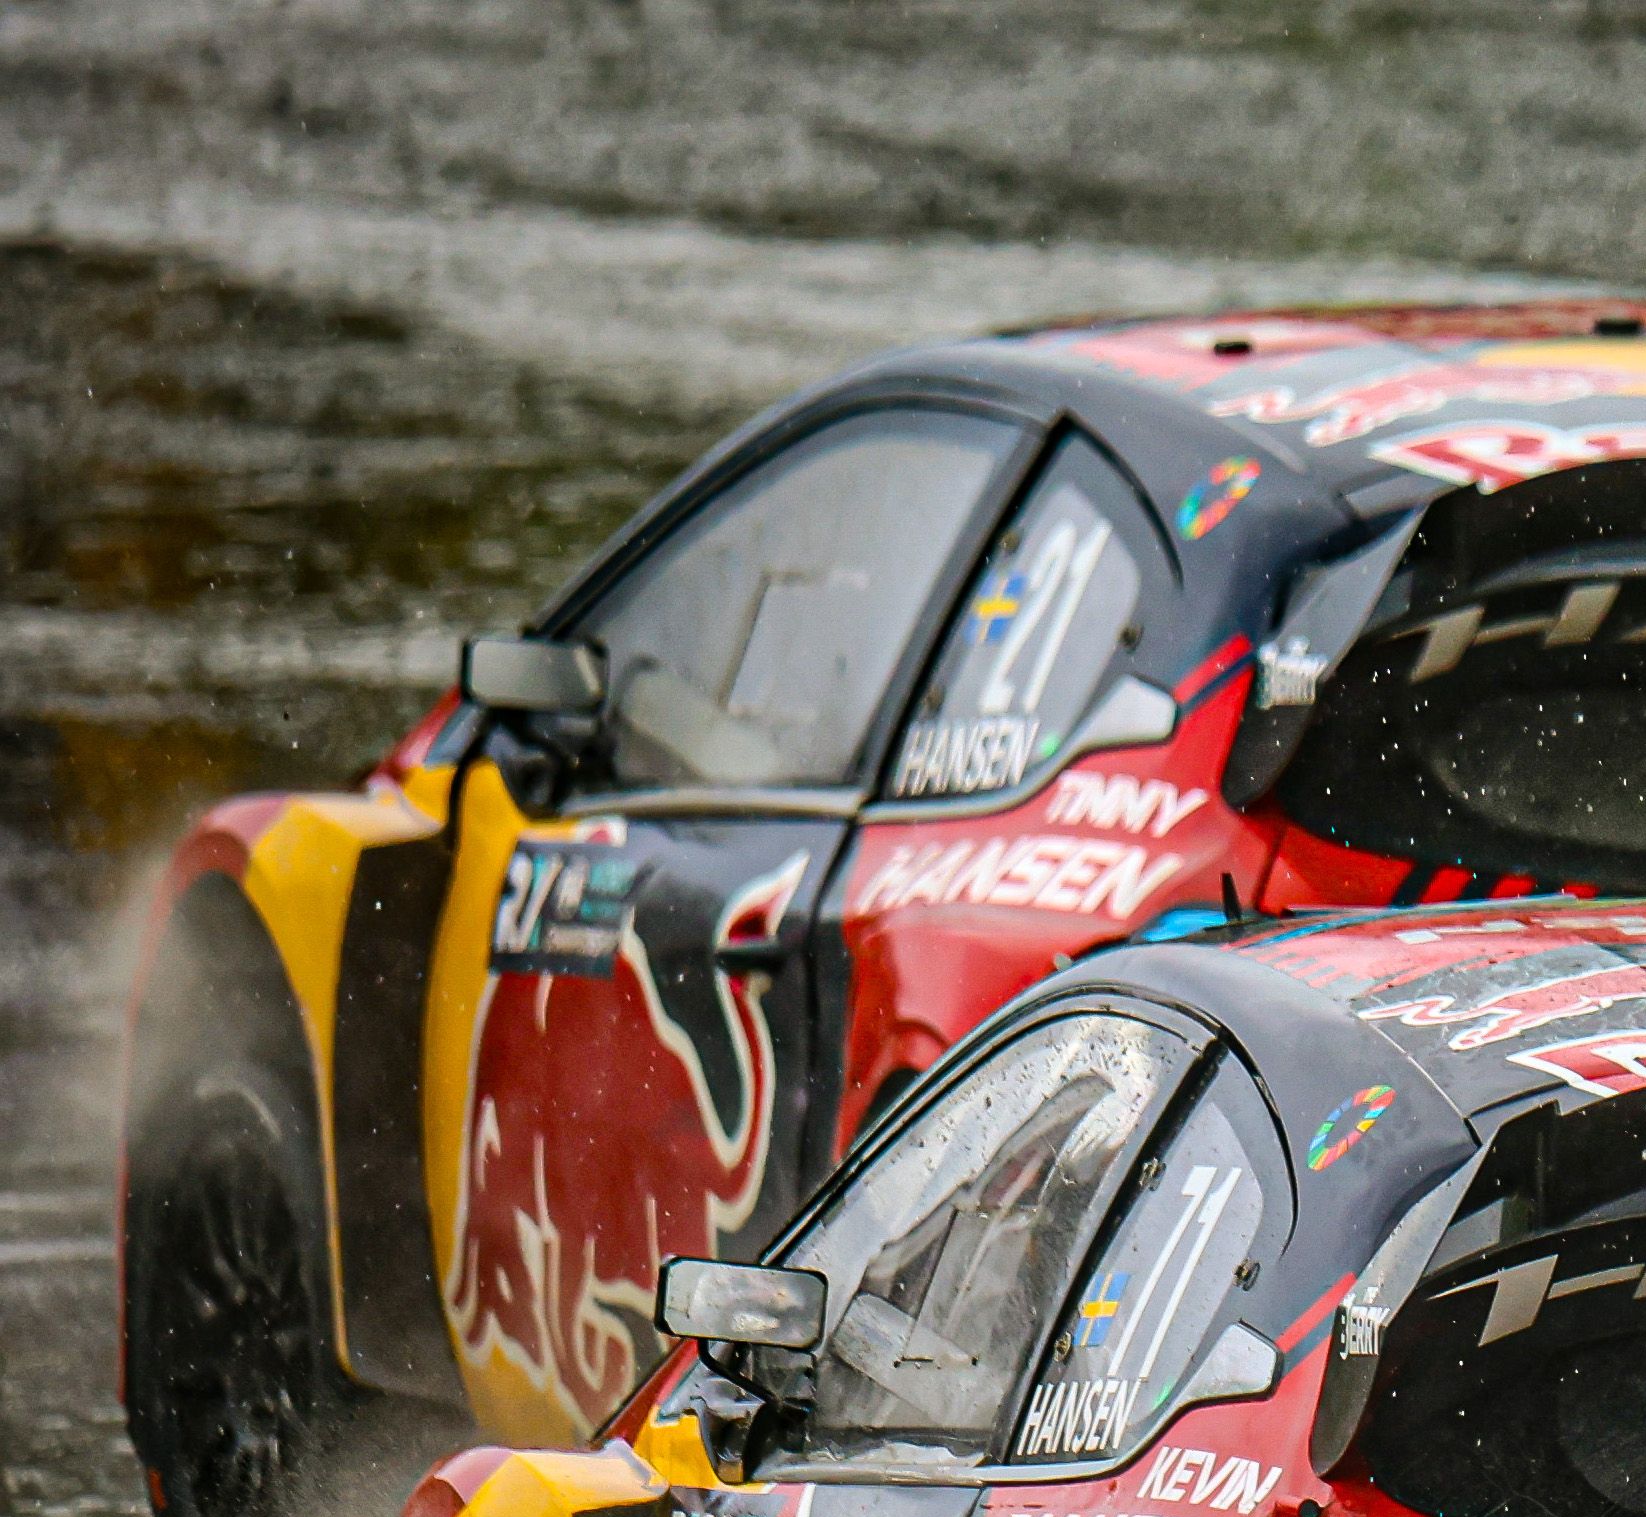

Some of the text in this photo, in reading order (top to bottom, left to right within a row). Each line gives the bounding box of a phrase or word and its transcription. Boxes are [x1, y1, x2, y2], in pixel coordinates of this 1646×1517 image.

[980, 519, 1113, 713] 21
[895, 717, 1040, 797] HANSEN
[856, 835, 1183, 921] HANSEN
[1017, 1378, 1142, 1456] HANSEN
[1137, 1446, 1283, 1515] KEVIN
